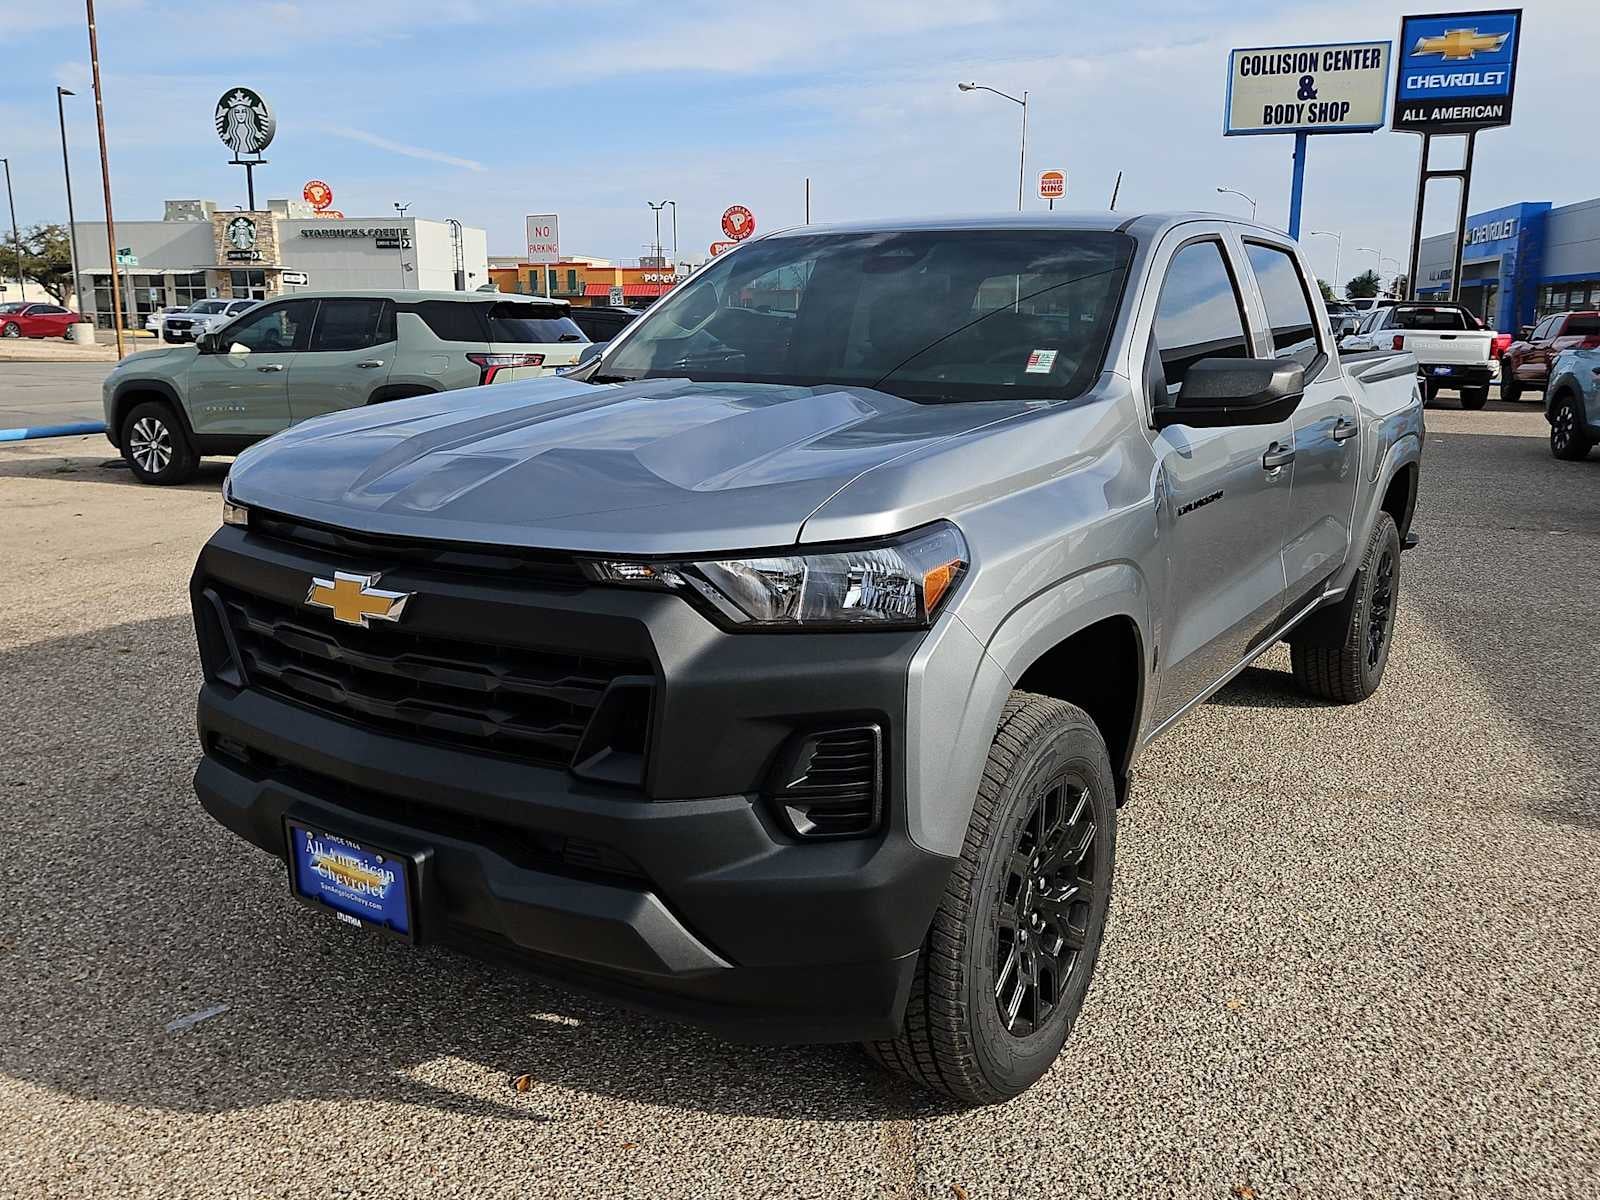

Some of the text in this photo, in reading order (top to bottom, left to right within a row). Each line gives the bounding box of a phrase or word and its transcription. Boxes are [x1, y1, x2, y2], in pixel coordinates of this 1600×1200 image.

[1240, 48, 1381, 76] COLLISION CENTER
[1297, 75, 1318, 101] &
[1406, 71, 1506, 89] CHEVROLET
[1263, 101, 1350, 125] BODY SHOP
[1402, 105, 1503, 121] ALL AMERICAN
[300, 228, 366, 239] STARBUCKS
[535, 226, 550, 238] NO
[1472, 219, 1516, 244] CHEVROLET
[529, 243, 558, 254] PARKING
[611, 297, 623, 305] 35
[324, 832, 346, 846] SINCE
[305, 839, 395, 883] All American
[317, 861, 385, 900] Chevrolet
[321, 883, 382, 909] SanAngeloChevy.com
